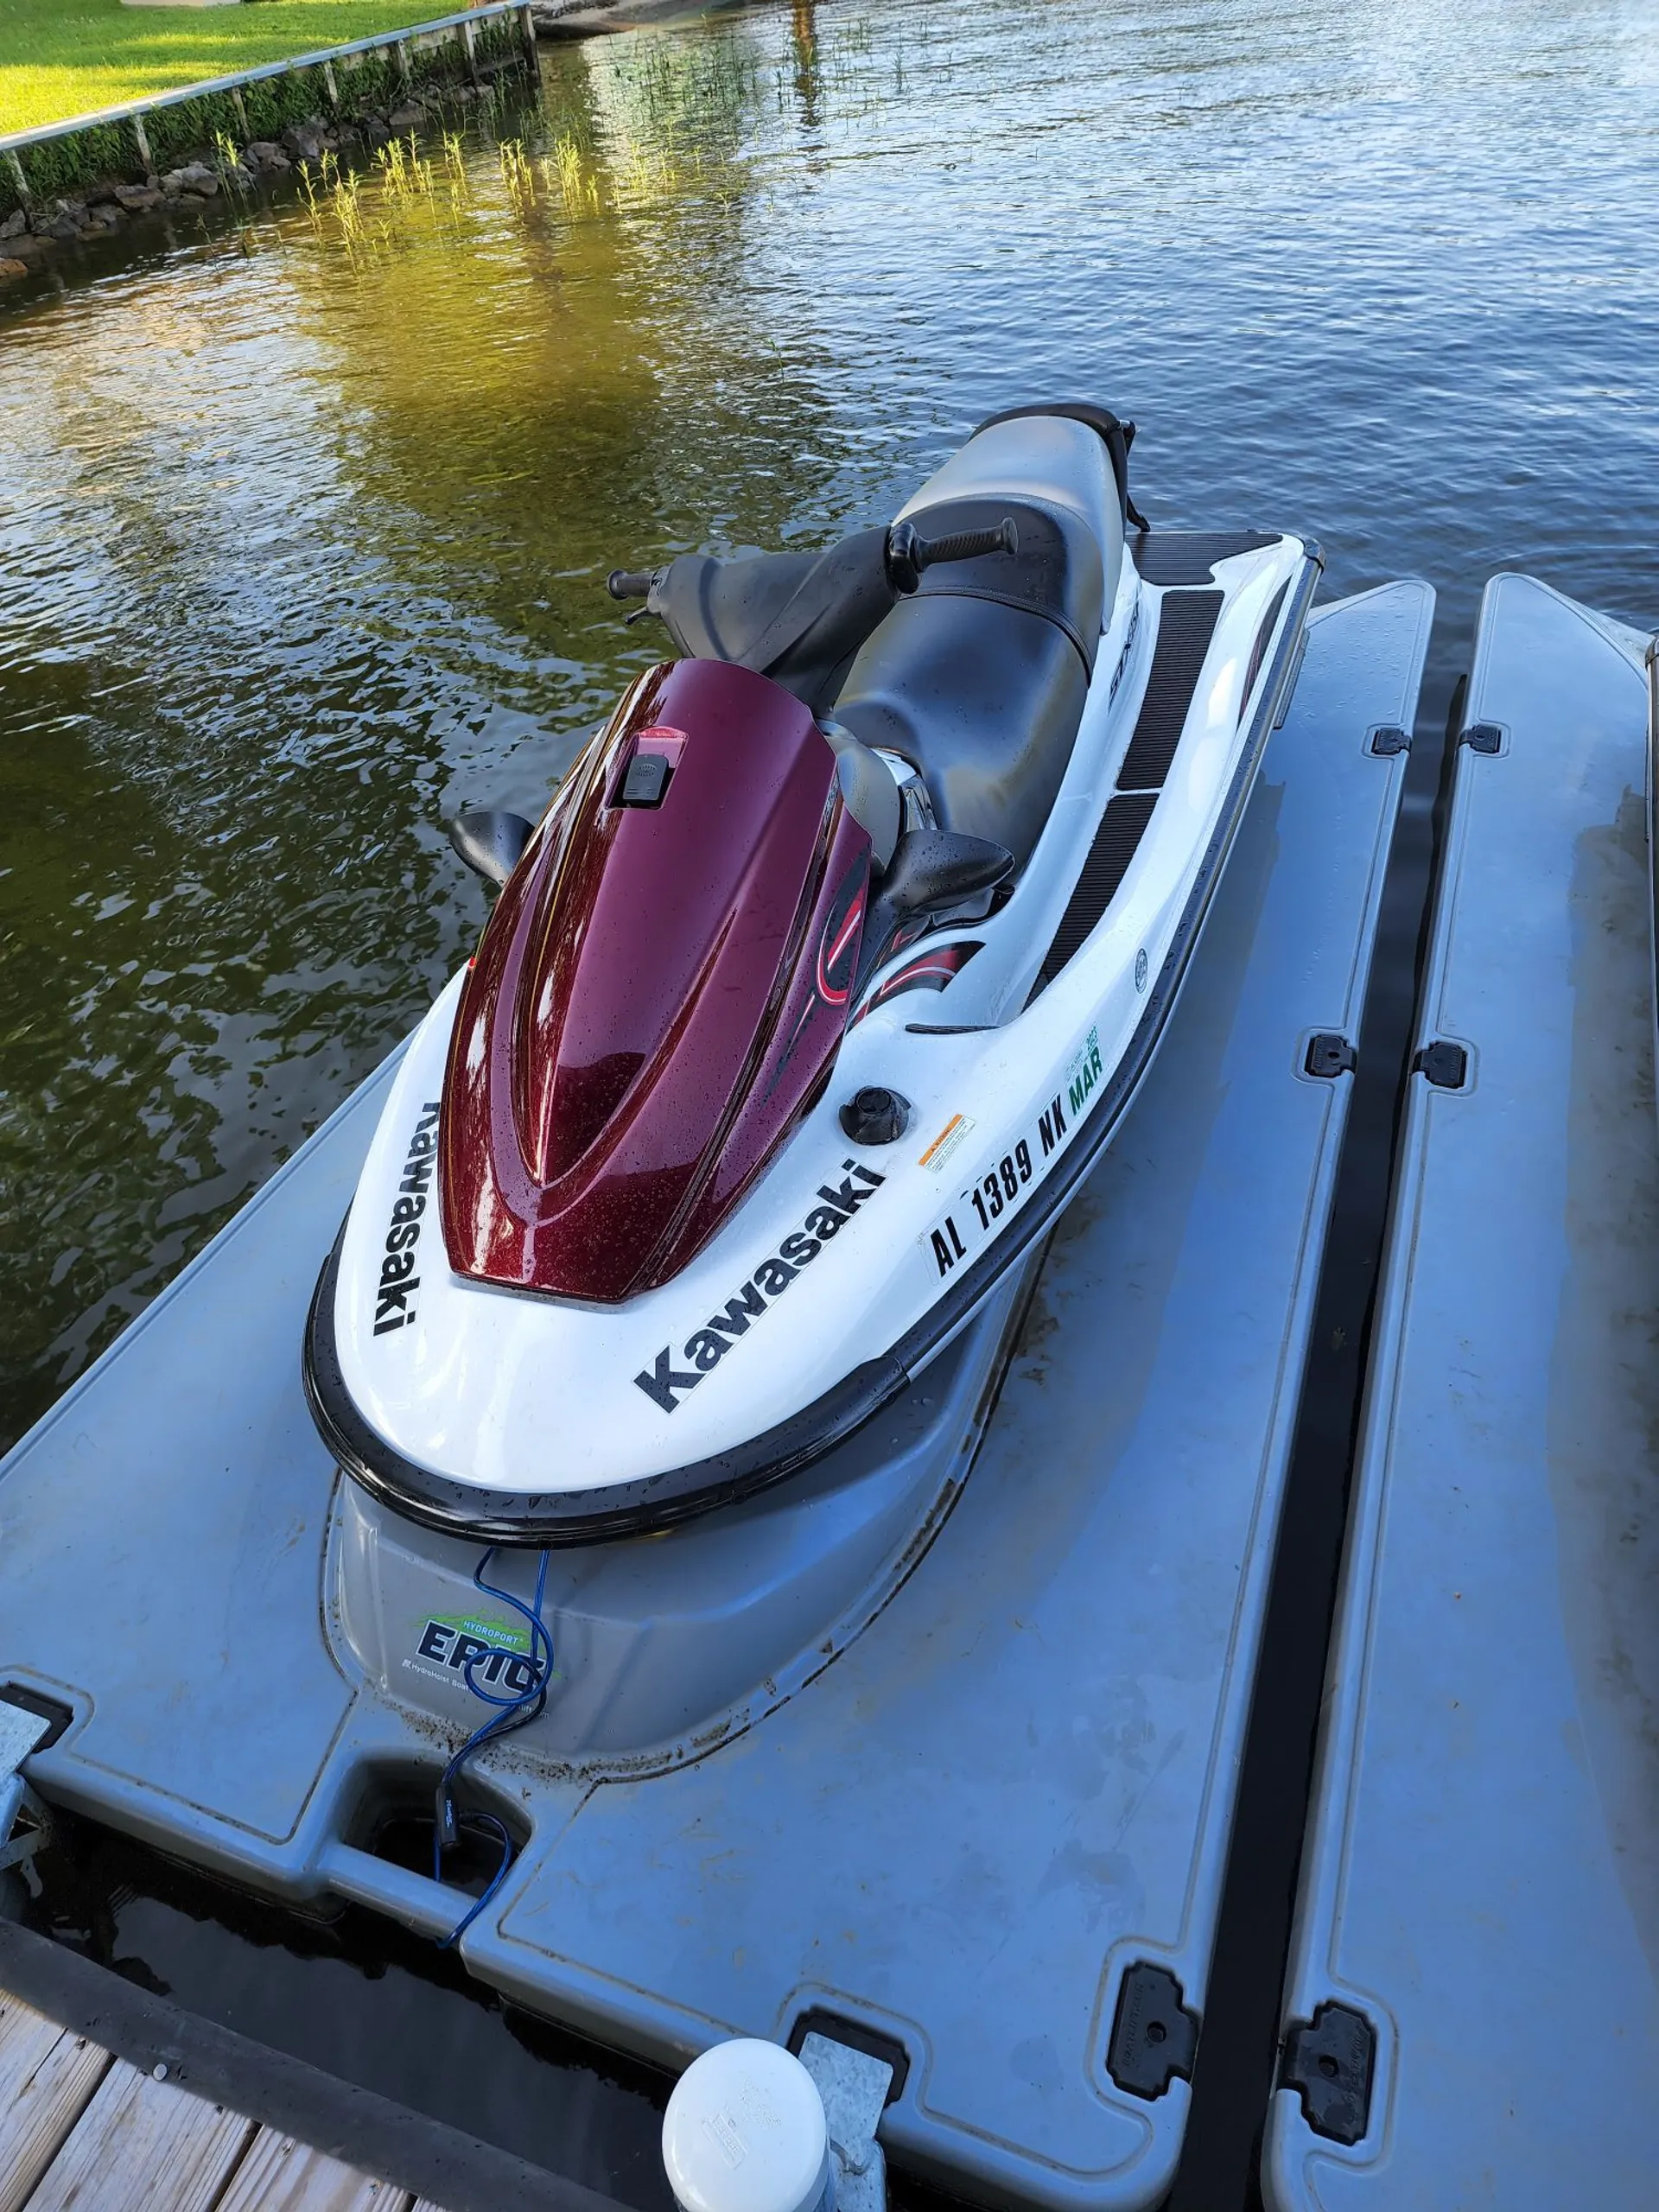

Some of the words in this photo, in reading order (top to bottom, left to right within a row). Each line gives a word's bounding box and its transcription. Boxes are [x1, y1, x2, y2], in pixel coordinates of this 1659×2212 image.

[1068, 1046, 1103, 1117] MAR
[930, 1217, 967, 1278] AL
[971, 1139, 1033, 1230] 1389
[1038, 1094, 1067, 1157] NK
[633, 1158, 887, 1415] Kawasaki
[416, 1619, 547, 1694] EPIC
[462, 1619, 518, 1645] HYDROPORT
[411, 1663, 450, 1685] HydroHoist
